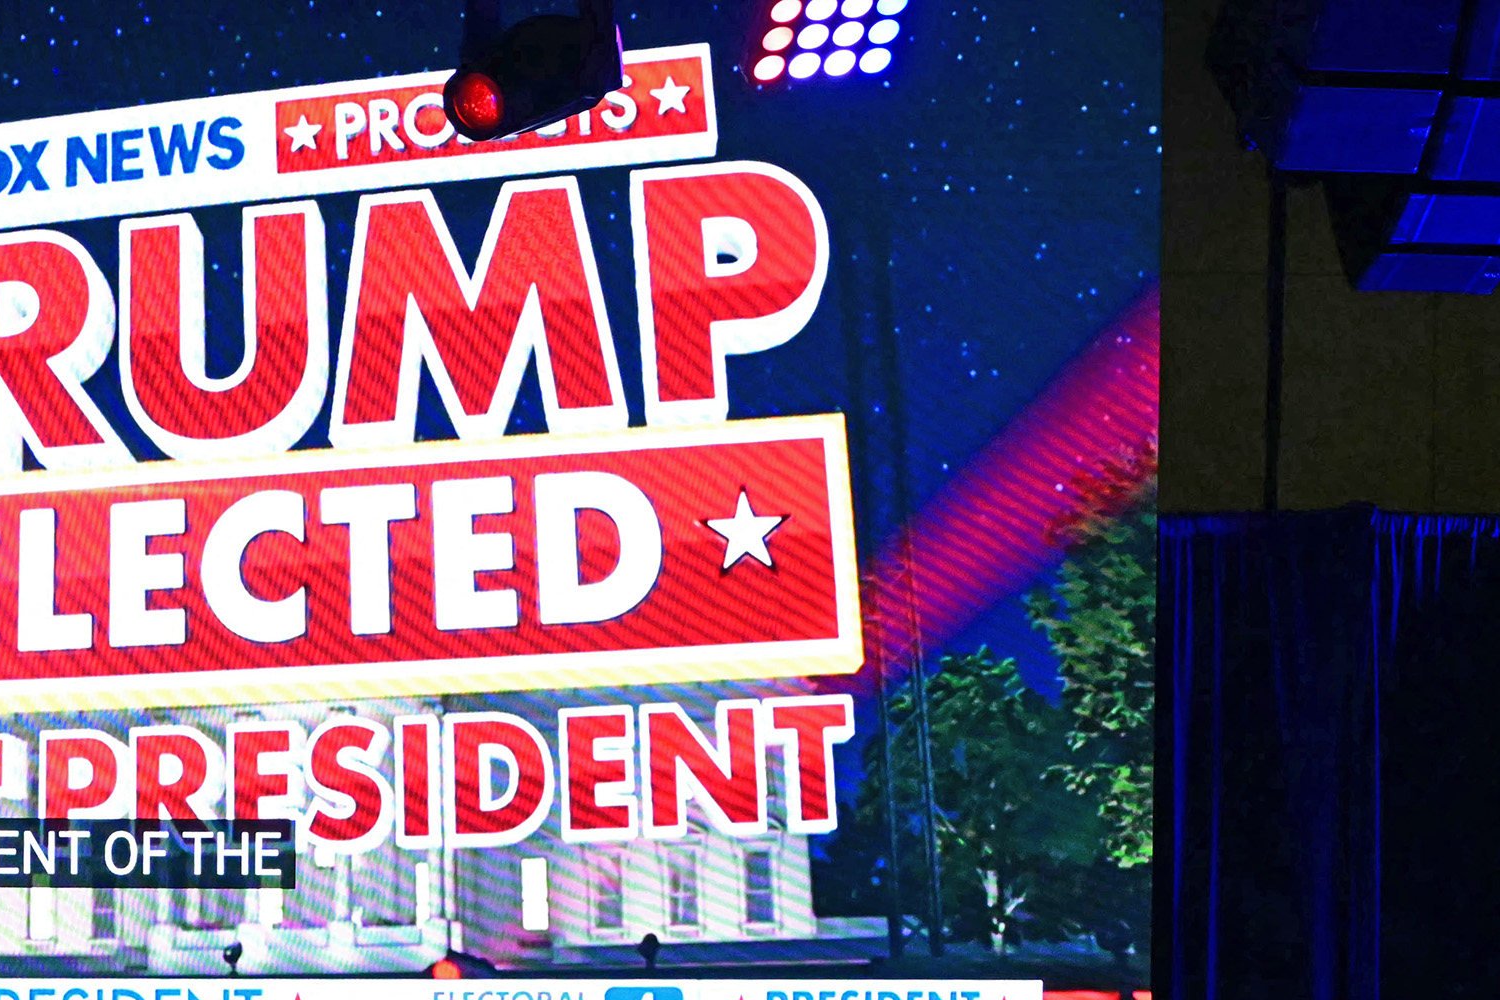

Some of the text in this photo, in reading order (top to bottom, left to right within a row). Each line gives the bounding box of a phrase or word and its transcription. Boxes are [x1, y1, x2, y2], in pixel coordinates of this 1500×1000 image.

[66, 117, 245, 188] NEWS
[334, 75, 638, 160] PROS
[42, 699, 852, 845] PRESIDENT
[103, 830, 173, 876] OF
[180, 831, 283, 877] THE
